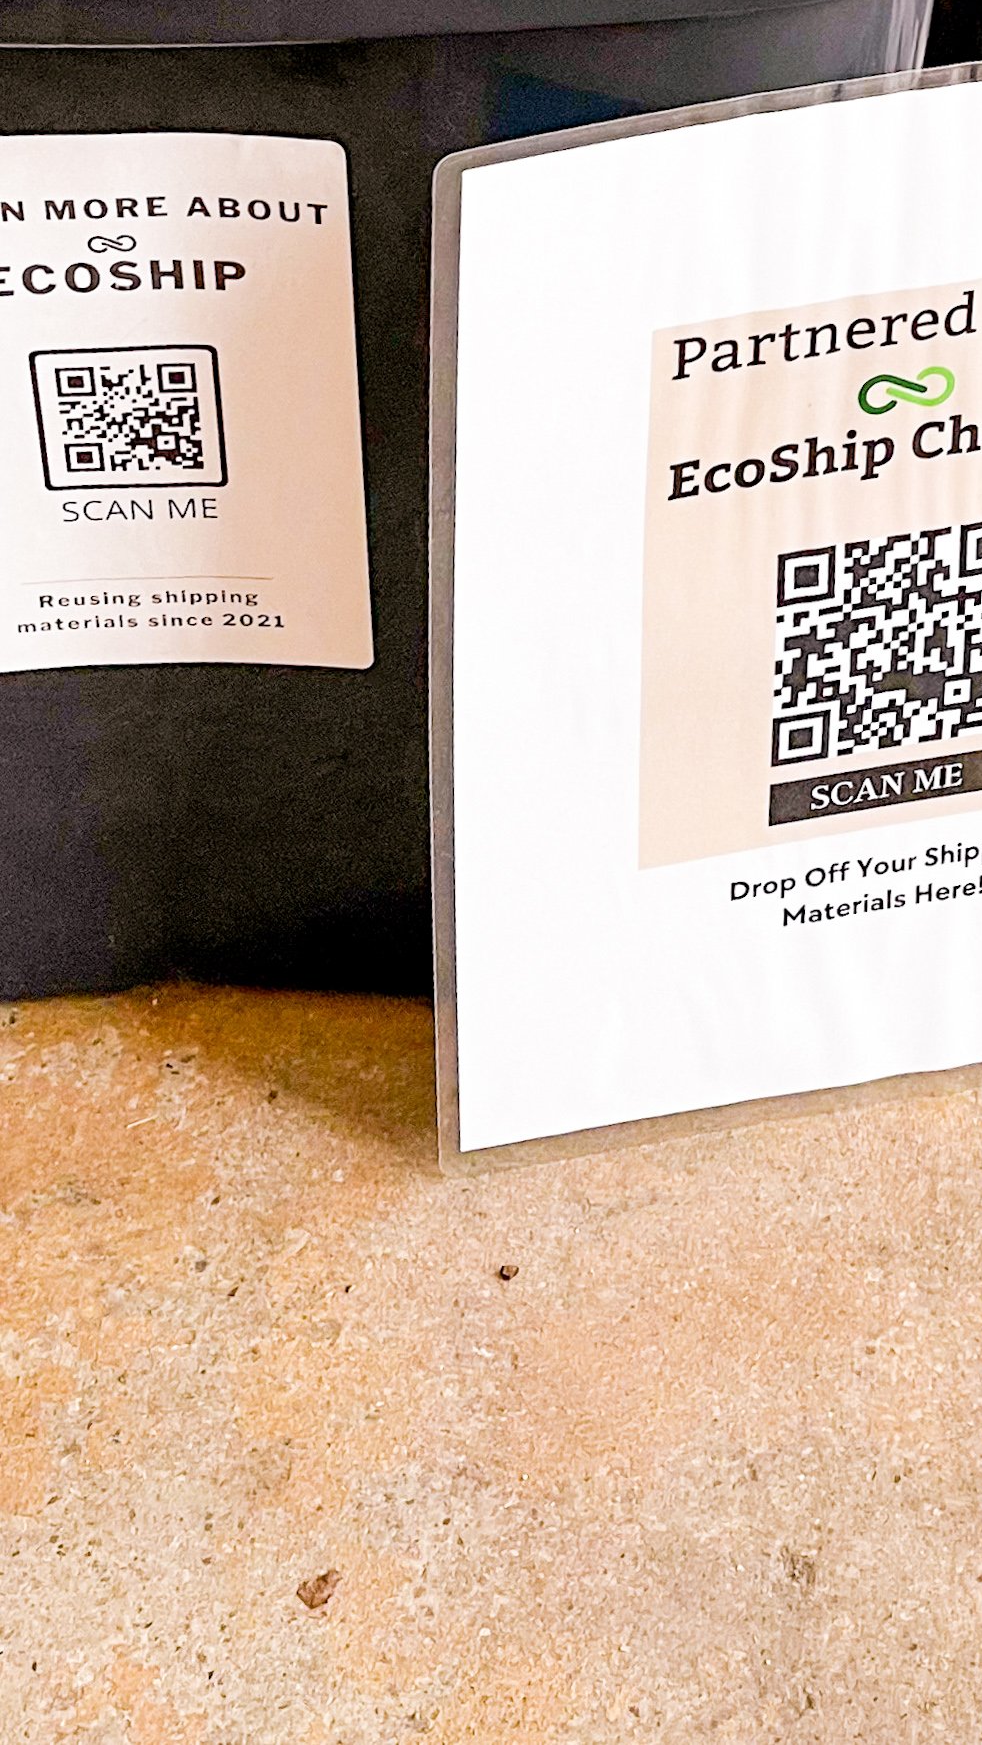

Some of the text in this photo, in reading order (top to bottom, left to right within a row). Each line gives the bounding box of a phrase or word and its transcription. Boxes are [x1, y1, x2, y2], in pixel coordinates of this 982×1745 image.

[44, 196, 168, 221] MORE
[186, 196, 328, 225] ABOUT
[0, 259, 246, 297] ECOSHIP
[671, 289, 977, 382] Partnered
[667, 429, 895, 501] EcoShip
[62, 497, 218, 523] SCAN ME
[39, 589, 258, 608] Reusing shipping
[17, 613, 285, 633] materials since 2021
[808, 762, 963, 812] SCAN ME
[730, 877, 796, 902] Drop
[805, 860, 851, 887] Off
[857, 856, 917, 878] Your
[782, 890, 905, 926] Materials
